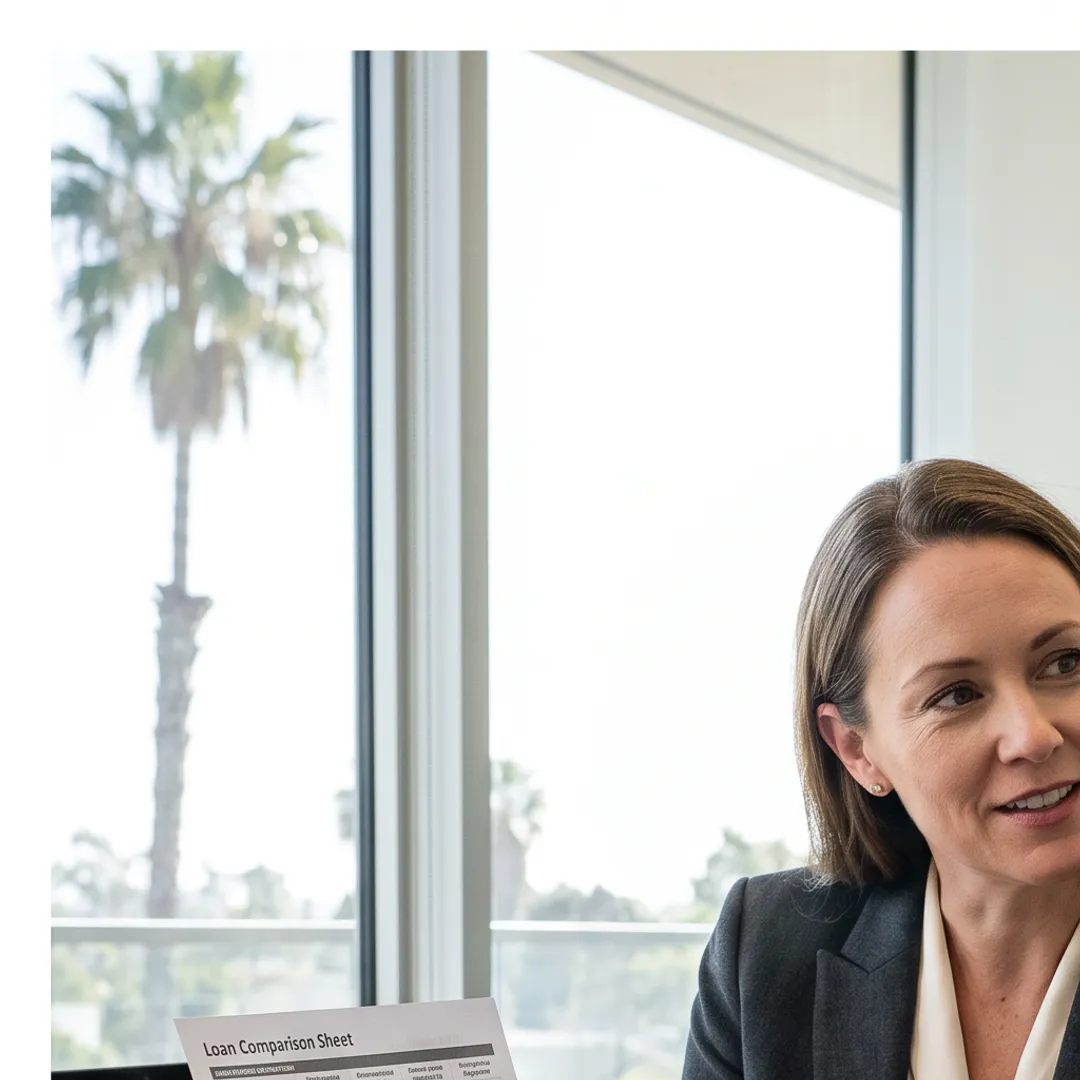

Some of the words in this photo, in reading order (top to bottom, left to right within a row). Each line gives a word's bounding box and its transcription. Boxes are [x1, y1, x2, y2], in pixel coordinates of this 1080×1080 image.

[203, 1042, 236, 1057] Loan
[239, 1036, 315, 1056] Comparison
[317, 1033, 354, 1049] Sheet
